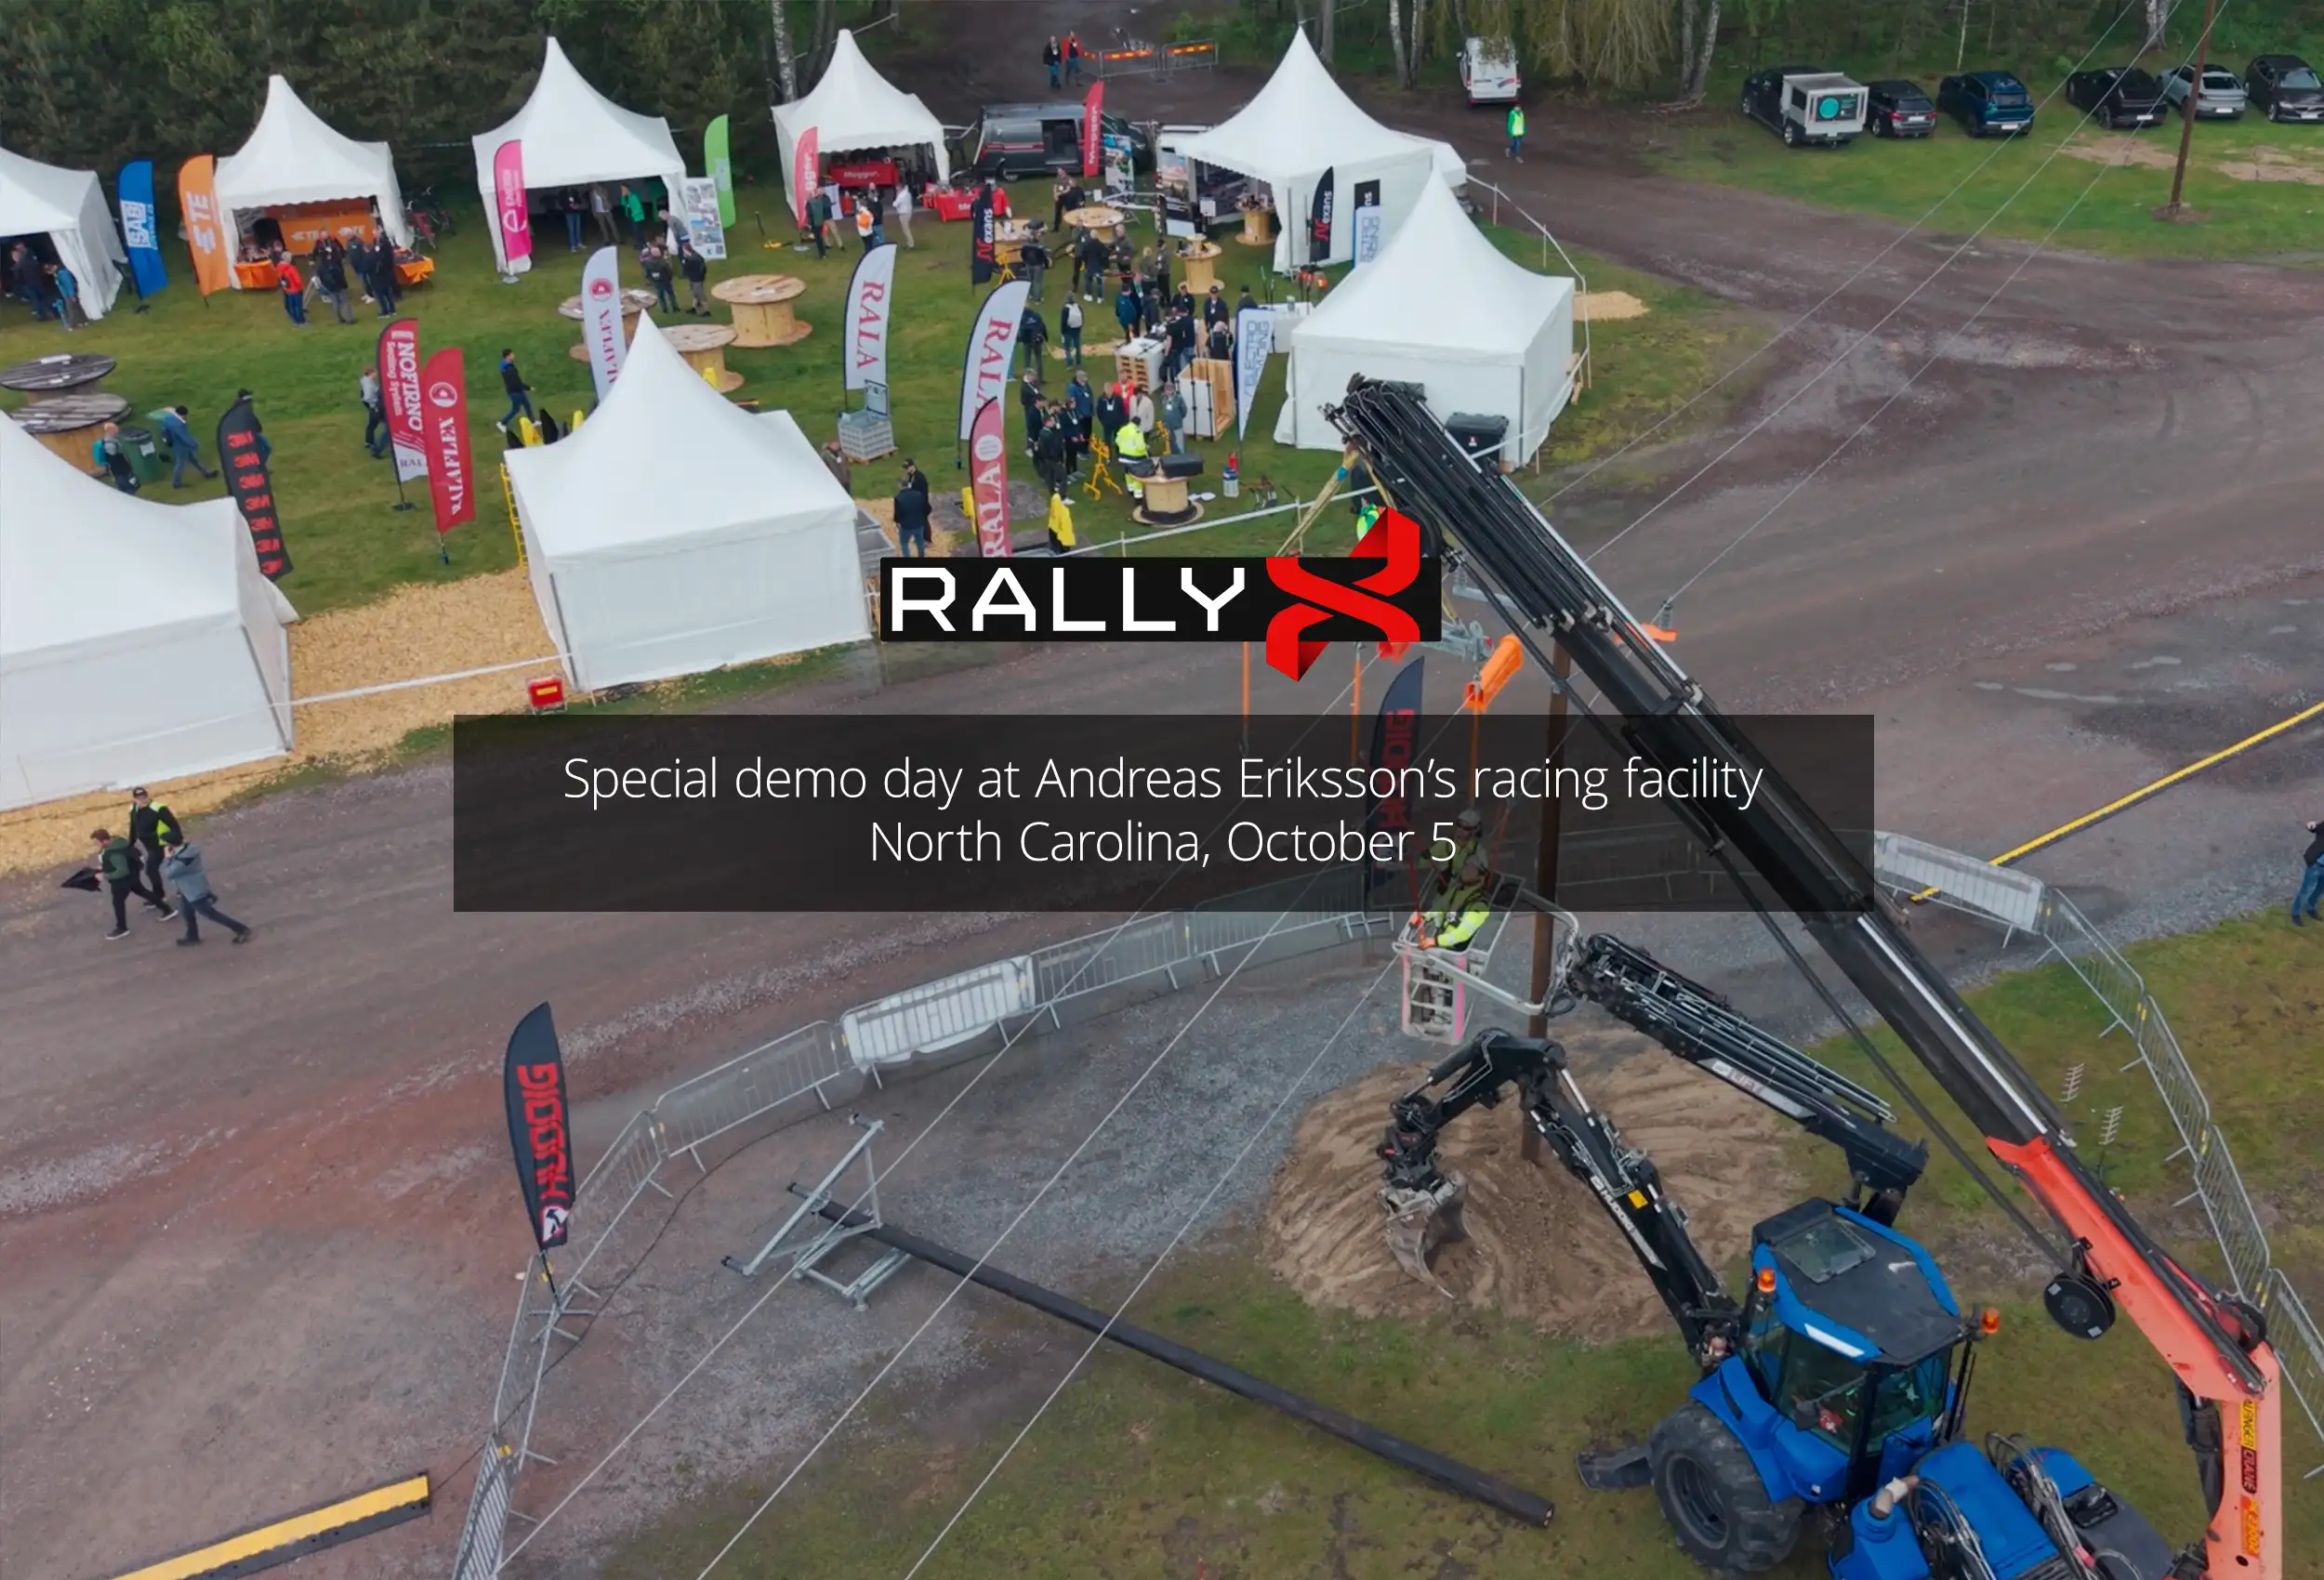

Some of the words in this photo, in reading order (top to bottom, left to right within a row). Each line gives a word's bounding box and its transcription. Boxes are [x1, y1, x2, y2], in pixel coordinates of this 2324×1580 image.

[599, 309, 618, 384] ALAFLEX
[856, 280, 885, 370] RALA
[397, 341, 424, 432] NOFIRNO
[234, 453, 260, 467] 3M
[239, 473, 265, 489] 3M
[439, 416, 464, 515] RALAFLEX
[244, 494, 271, 510] 3M
[250, 516, 273, 532] 3M
[516, 1062, 569, 1200] HUDDIG
